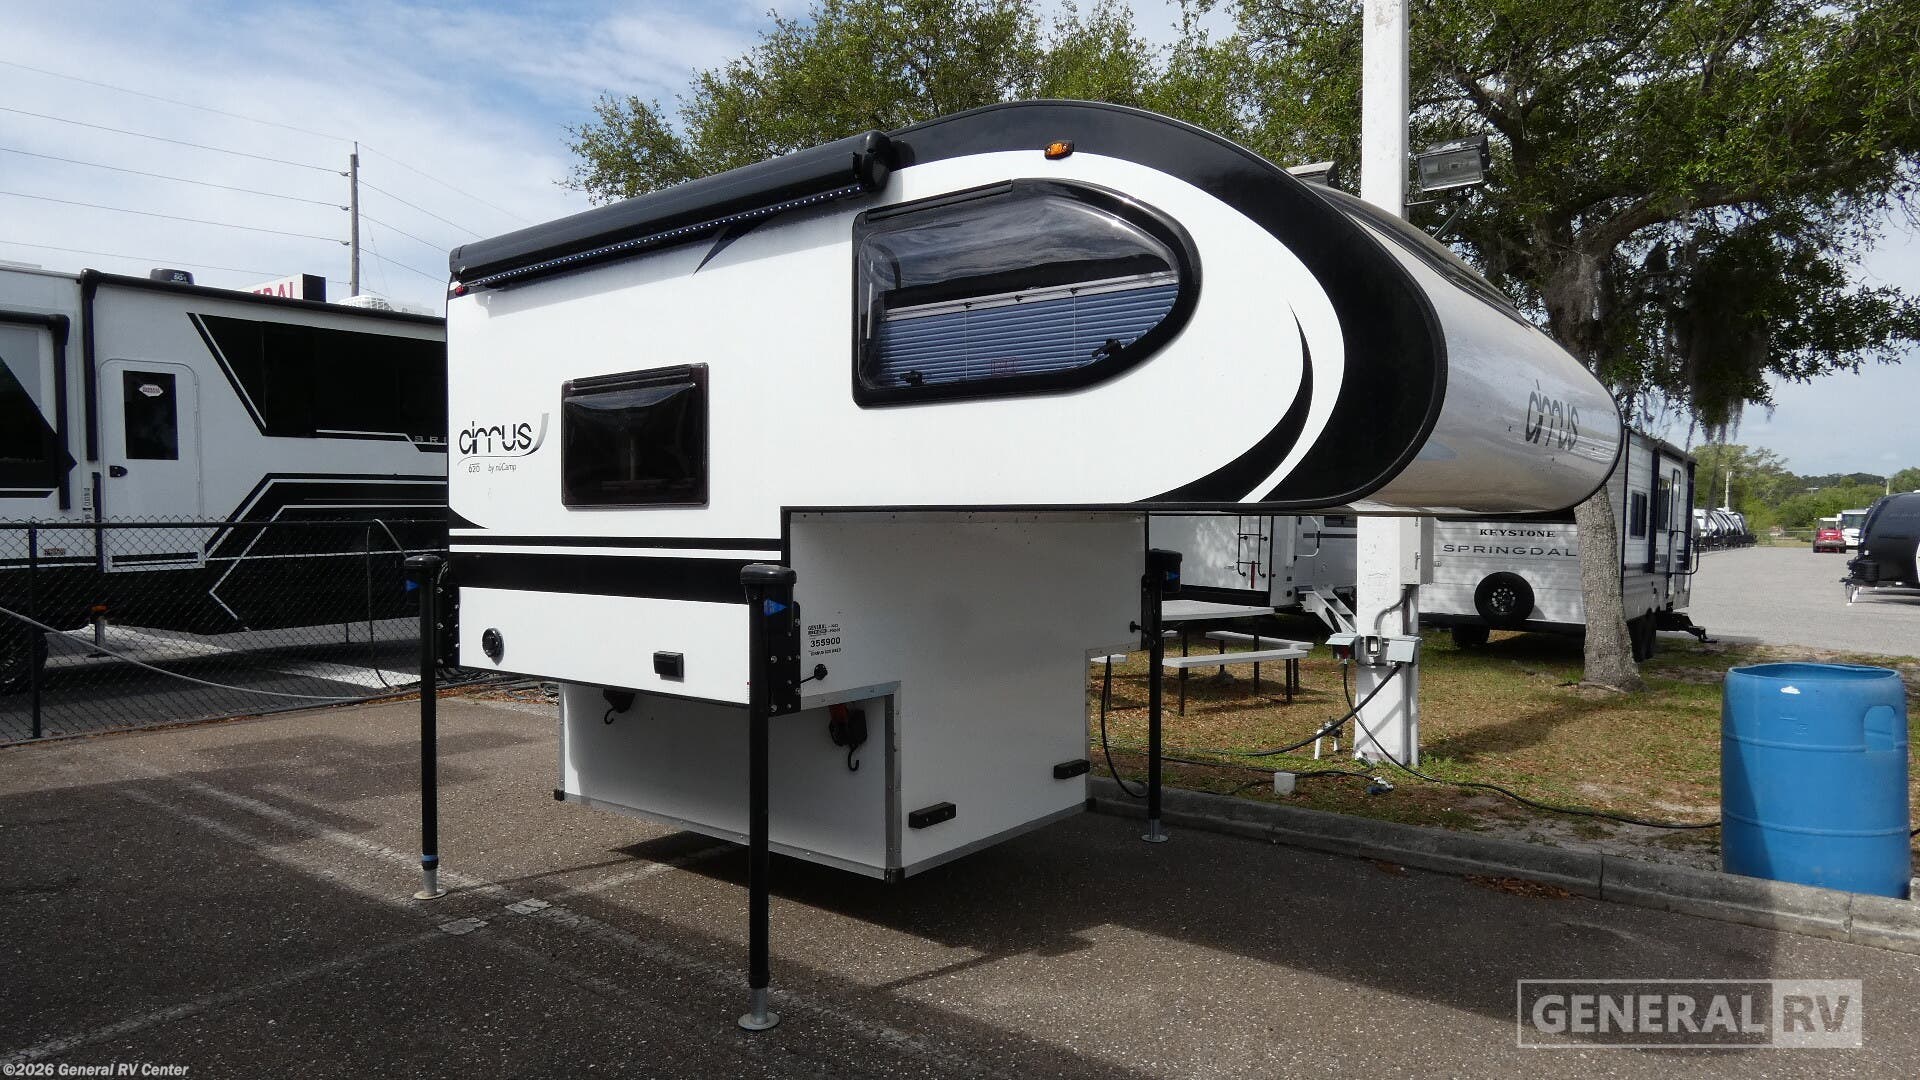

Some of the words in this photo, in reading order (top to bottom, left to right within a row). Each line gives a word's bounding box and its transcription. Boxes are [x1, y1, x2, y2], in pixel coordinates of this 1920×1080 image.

[1525, 379, 1580, 451] cirrus
[459, 420, 532, 455] cirrus
[1480, 529, 1556, 538] KEYSTONE
[810, 637, 841, 648] 355900
